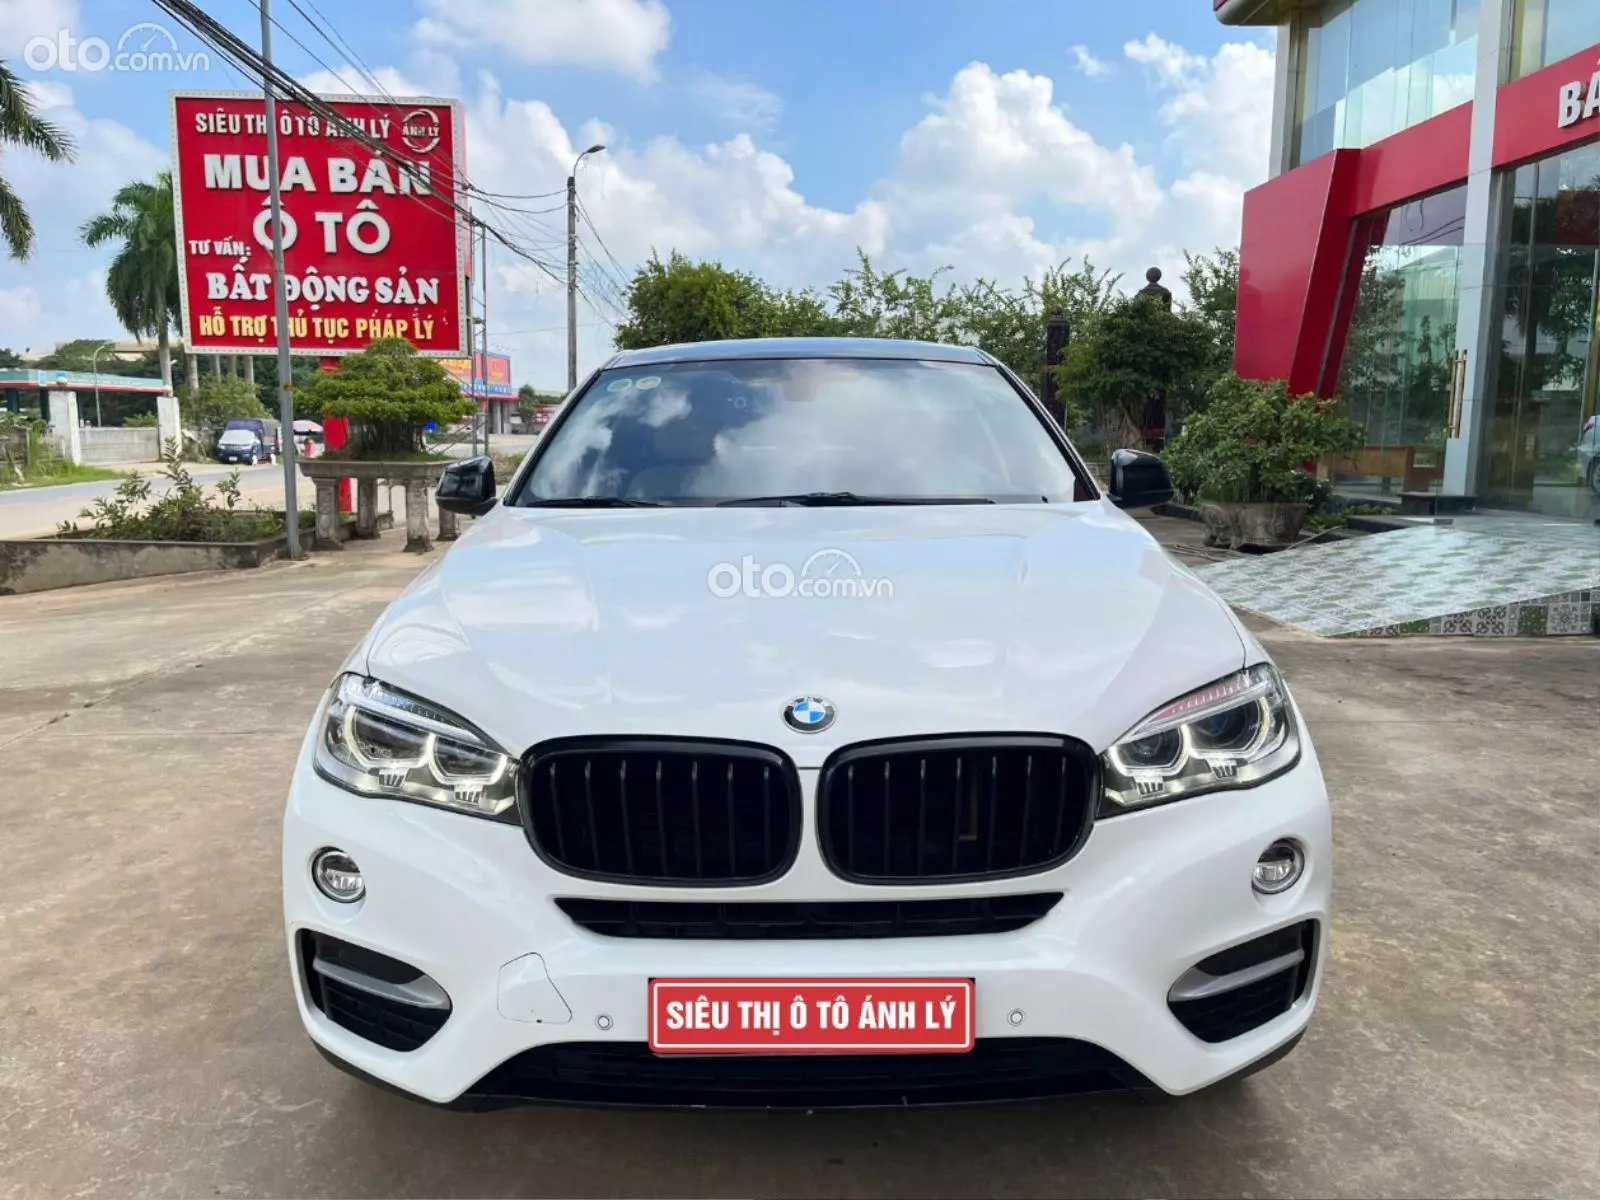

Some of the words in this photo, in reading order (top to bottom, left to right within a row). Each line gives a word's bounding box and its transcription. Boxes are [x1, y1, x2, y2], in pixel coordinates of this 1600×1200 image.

[195, 107, 241, 133] SIÊU
[244, 113, 270, 135] TH
[280, 109, 293, 136] Ô
[370, 114, 391, 139] LÝ
[203, 153, 317, 192] MUA
[327, 149, 433, 196] BÁN
[252, 195, 298, 252] Ô
[314, 199, 391, 255] TÔ
[188, 239, 211, 255] TƯ
[205, 256, 272, 301] BẤT
[283, 265, 370, 311] ĐỘNG
[374, 265, 439, 305] SẢN
[199, 306, 226, 337] HỖ
[229, 314, 268, 343] TRỢ
[312, 317, 349, 344] TỤC
[355, 313, 408, 339] PHÁP
[413, 313, 434, 340] LÝ
